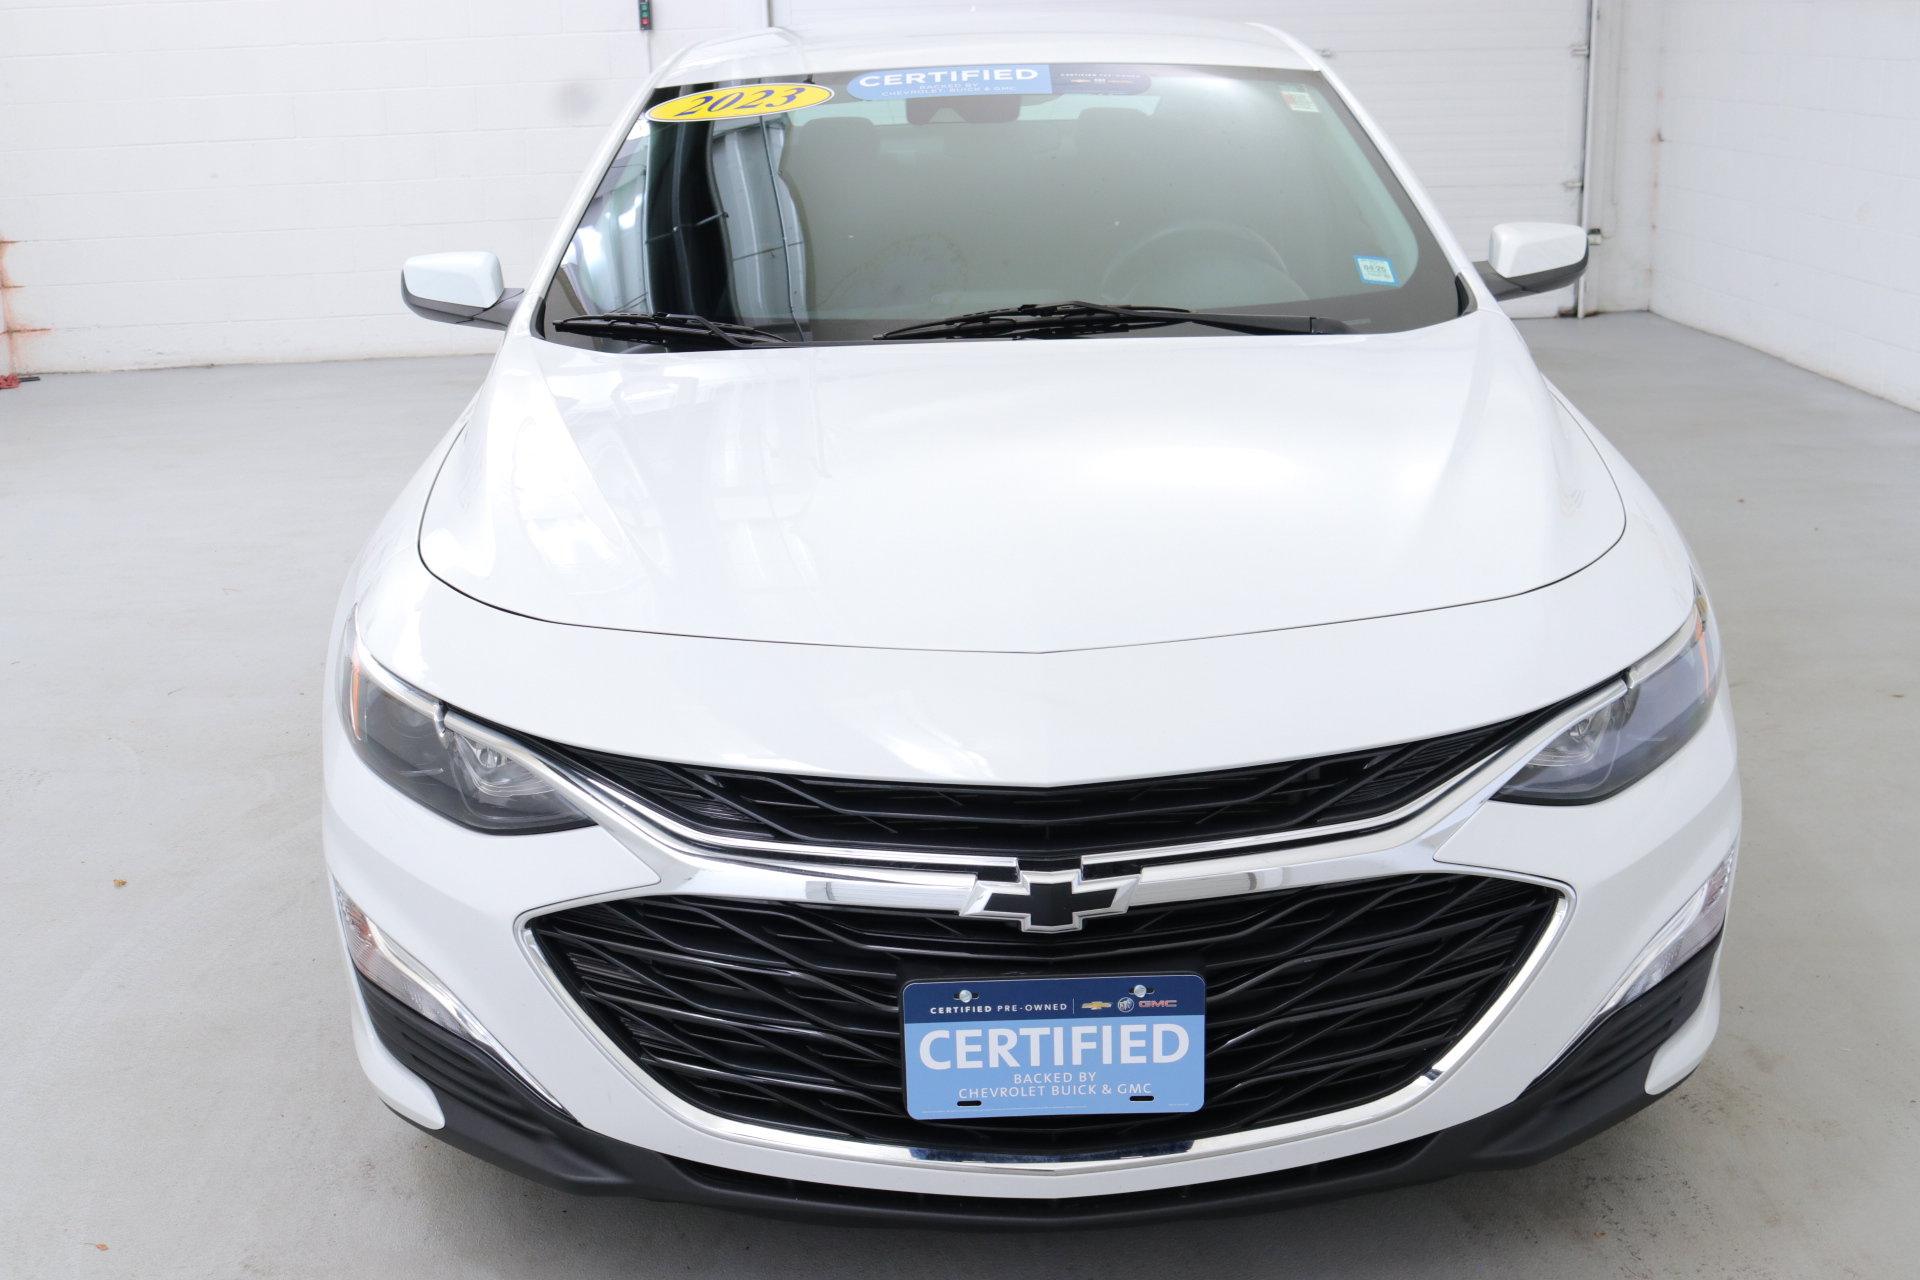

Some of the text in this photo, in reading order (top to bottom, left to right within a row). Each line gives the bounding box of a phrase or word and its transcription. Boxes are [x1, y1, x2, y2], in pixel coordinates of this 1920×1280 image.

[859, 68, 1038, 87] CERTIFIED
[674, 87, 806, 117] 2023
[930, 1000, 1178, 1014] CERTIFIED PRE-OWNED GMC
[919, 1023, 1189, 1070] CERTIFIED
[1014, 1071, 1097, 1084] BACKED BY
[958, 1083, 1152, 1099] CHEVROLET BUICK & GMC
